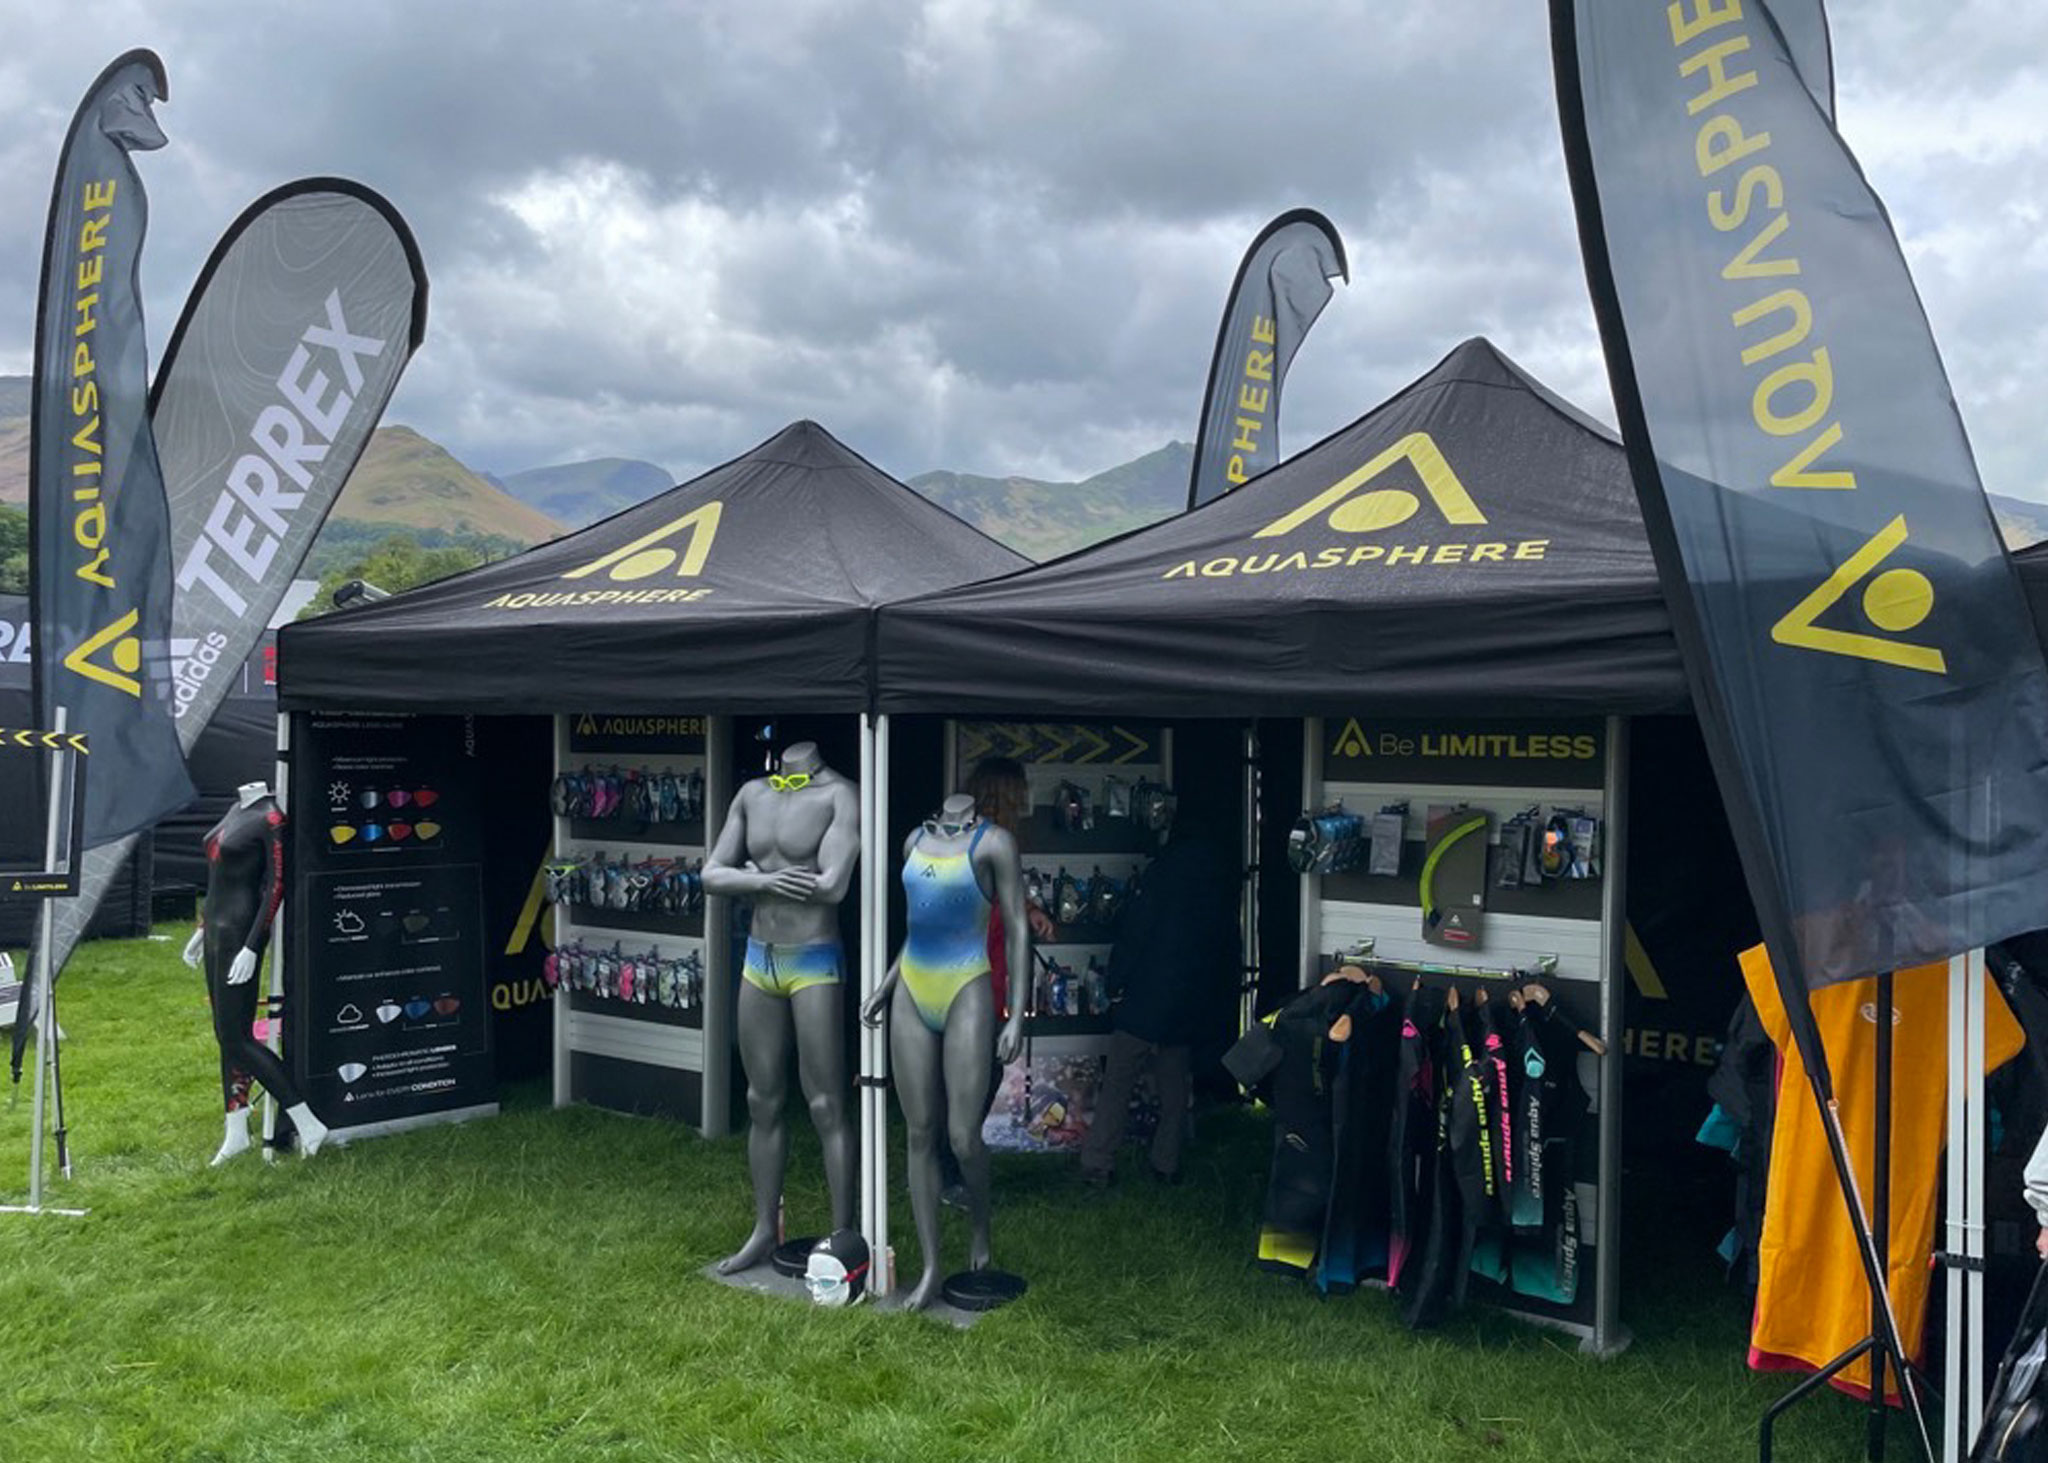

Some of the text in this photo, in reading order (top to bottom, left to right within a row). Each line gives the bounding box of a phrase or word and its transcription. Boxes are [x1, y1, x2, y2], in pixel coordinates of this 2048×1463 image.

[72, 179, 116, 589] AQUASPHERE
[177, 288, 386, 618] TERREX
[1163, 539, 1550, 579] AQUASPHERE
[481, 588, 714, 609] AQUASPHERE
[167, 631, 228, 718] adidas
[1380, 733, 1596, 759] Be LIMITLESS
[1526, 1094, 1542, 1139] Aqua
